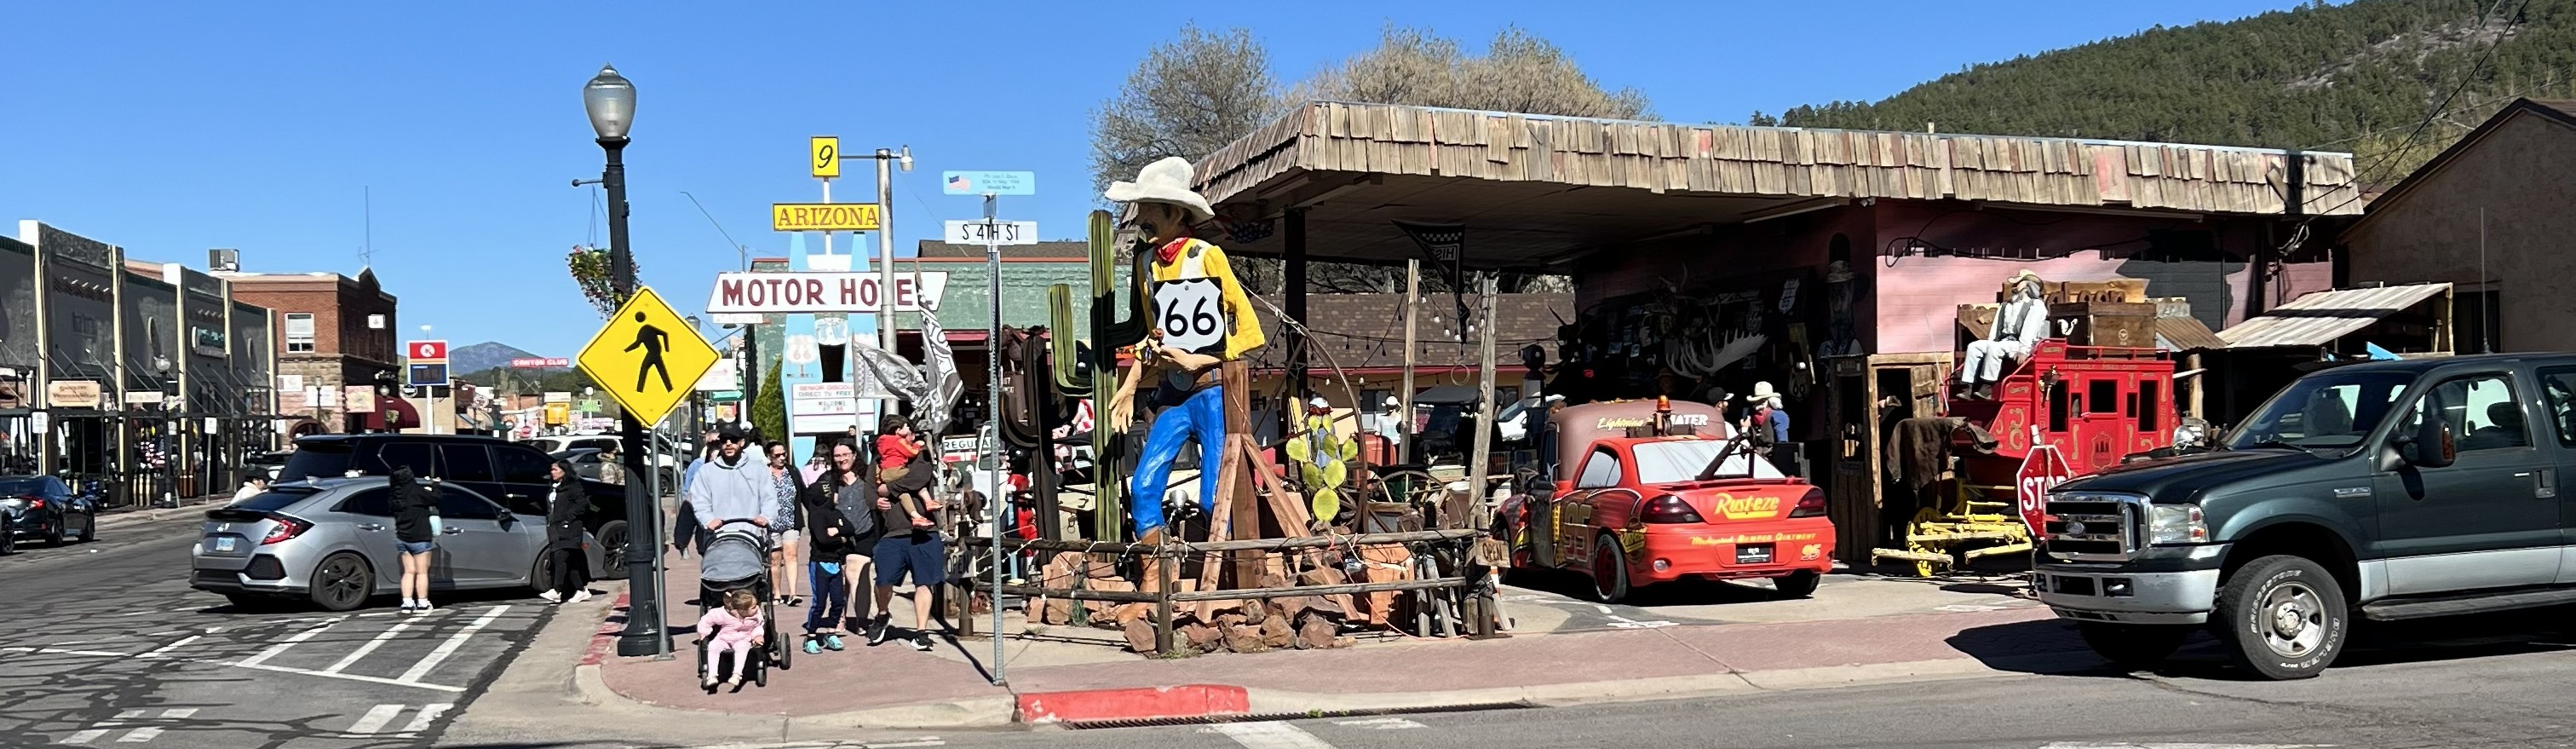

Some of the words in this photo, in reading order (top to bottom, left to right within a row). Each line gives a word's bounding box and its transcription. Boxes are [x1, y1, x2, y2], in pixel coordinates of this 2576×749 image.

[817, 144, 834, 169] 9
[778, 207, 880, 227] ARIZONA
[962, 223, 969, 240] S
[976, 223, 999, 241] 4TH
[1006, 223, 1021, 241] ST
[722, 278, 828, 307] MOTOR
[1164, 295, 1217, 337] 66
[793, 349, 812, 360] 66
[1596, 417, 1644, 431] Lightning
[1482, 542, 1503, 562] OPEN
[1800, 543, 1822, 562] 95
